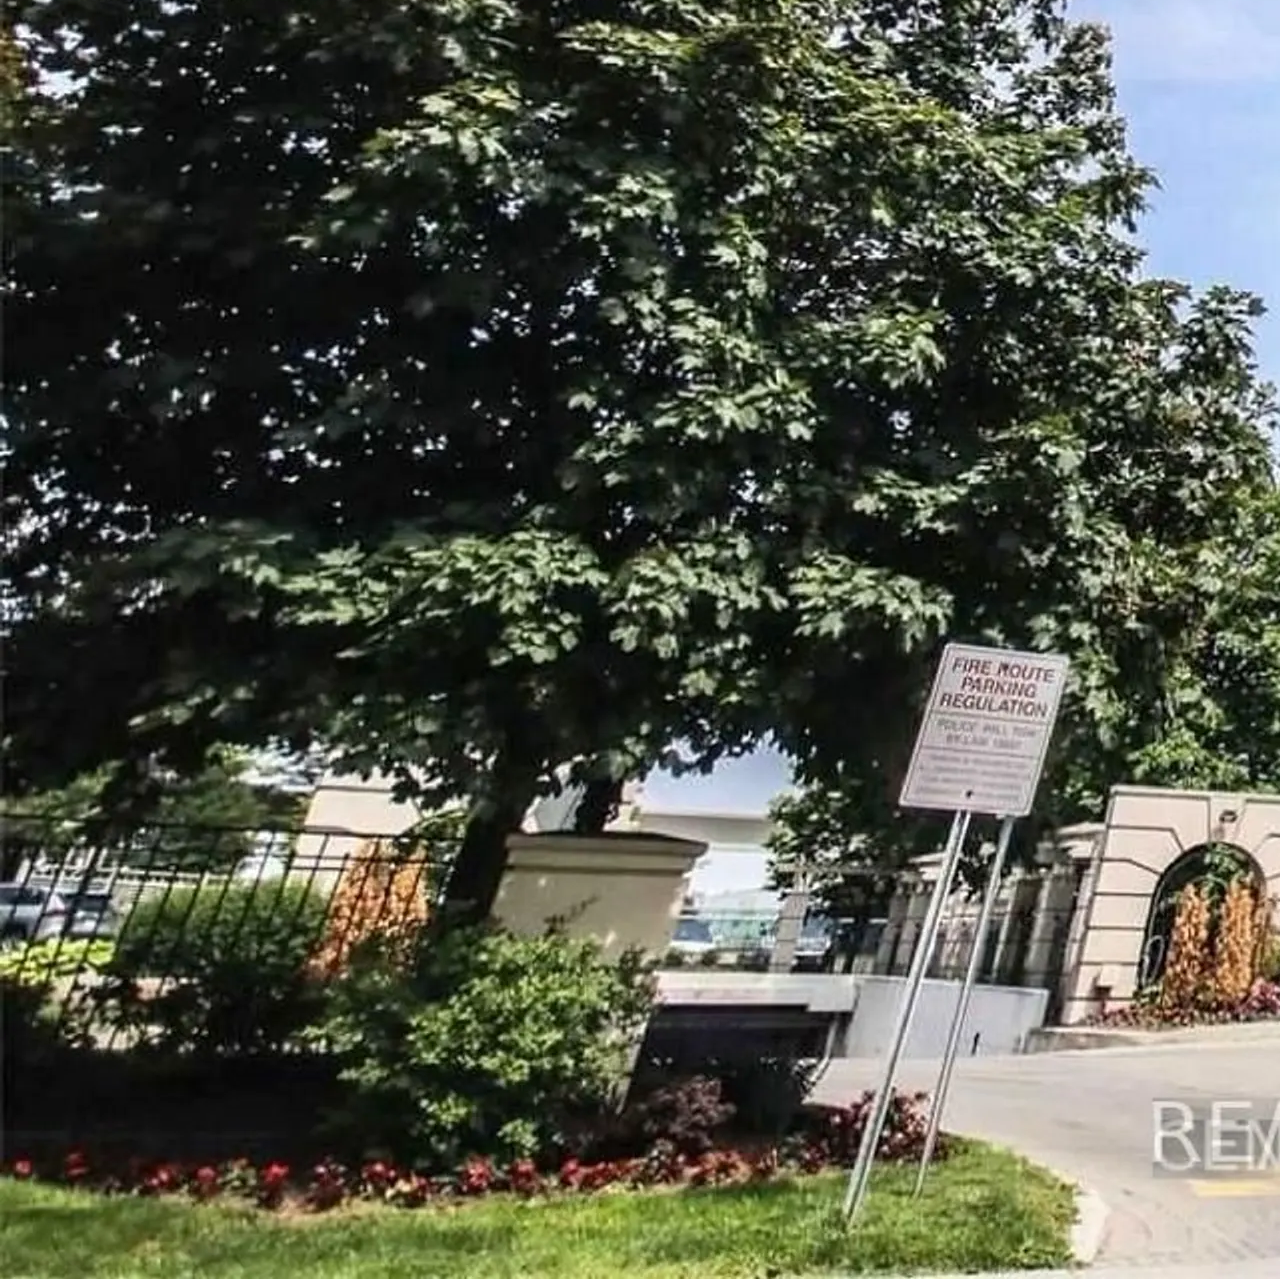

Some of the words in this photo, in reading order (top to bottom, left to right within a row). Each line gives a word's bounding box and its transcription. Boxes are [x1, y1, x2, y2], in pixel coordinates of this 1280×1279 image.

[952, 657, 992, 676] FIRE
[997, 661, 1056, 683] ROUTE
[961, 676, 1037, 698] PARKING
[939, 693, 1048, 718] REGULATION
